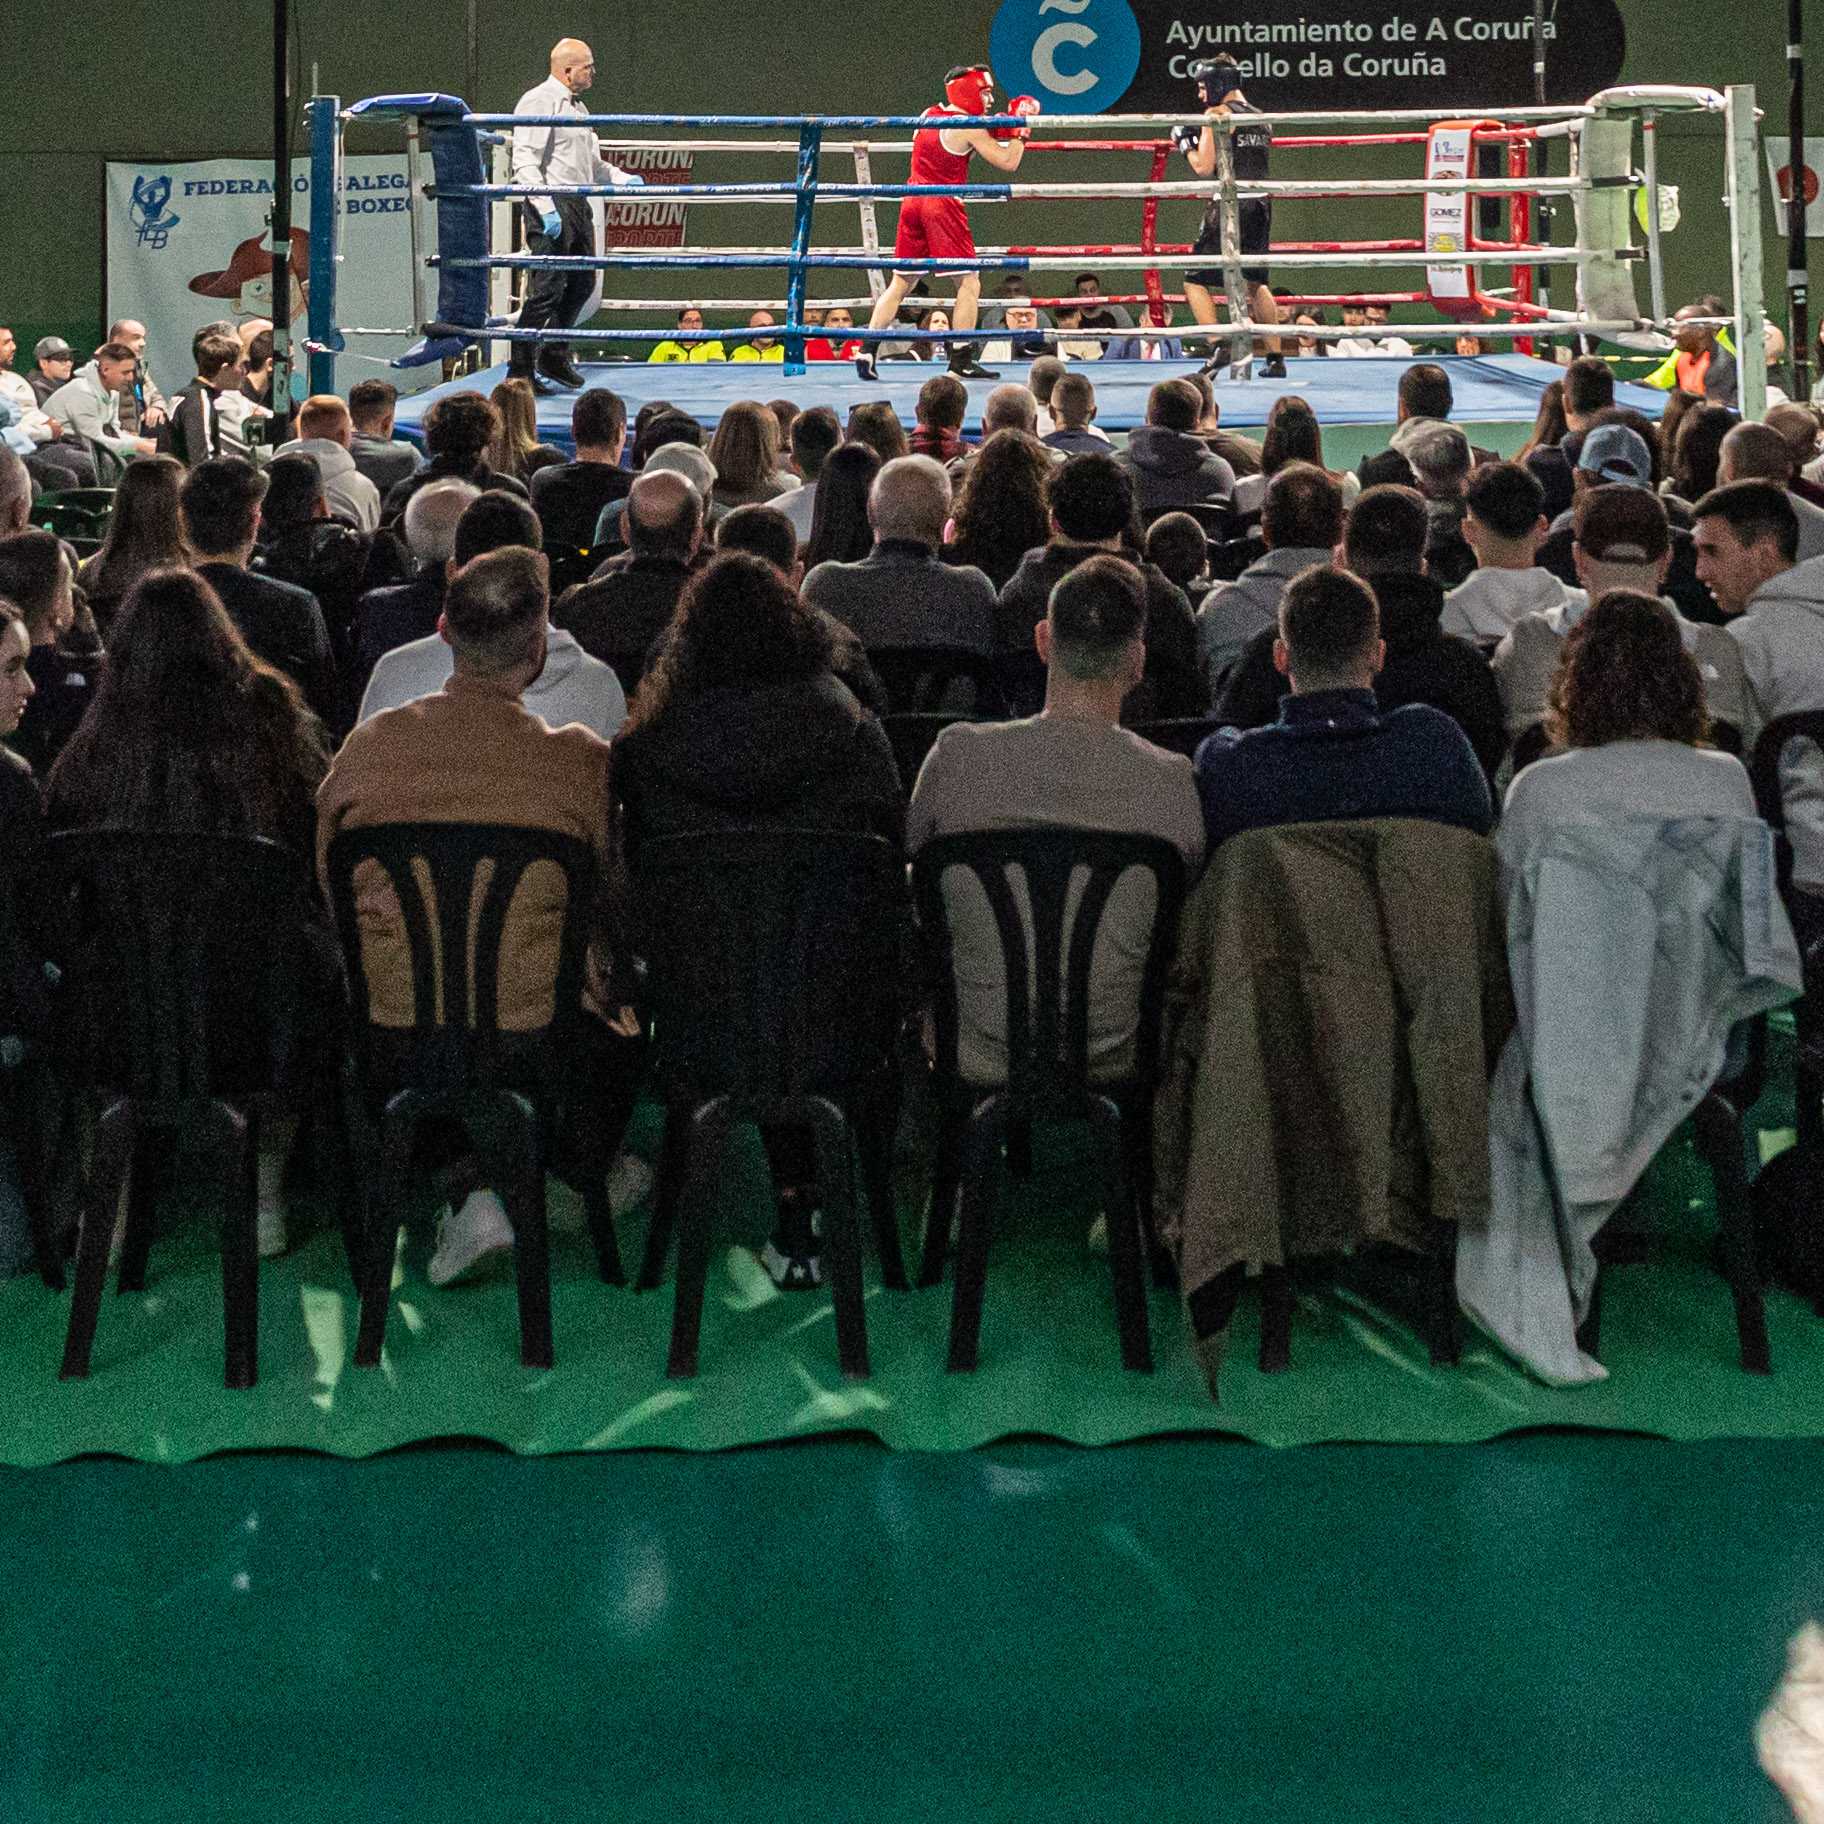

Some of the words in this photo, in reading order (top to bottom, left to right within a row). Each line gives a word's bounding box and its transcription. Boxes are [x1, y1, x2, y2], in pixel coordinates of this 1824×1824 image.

[1166, 18, 1373, 50] Ayuntamiento
[1381, 17, 1417, 41] de
[1425, 17, 1448, 41] A
[1454, 16, 1557, 40] Coruña
[1168, 52, 1290, 78] Coello
[1298, 52, 1333, 78] da
[1343, 52, 1447, 77] Coruña
[184, 174, 309, 196] FEDERAÓ
